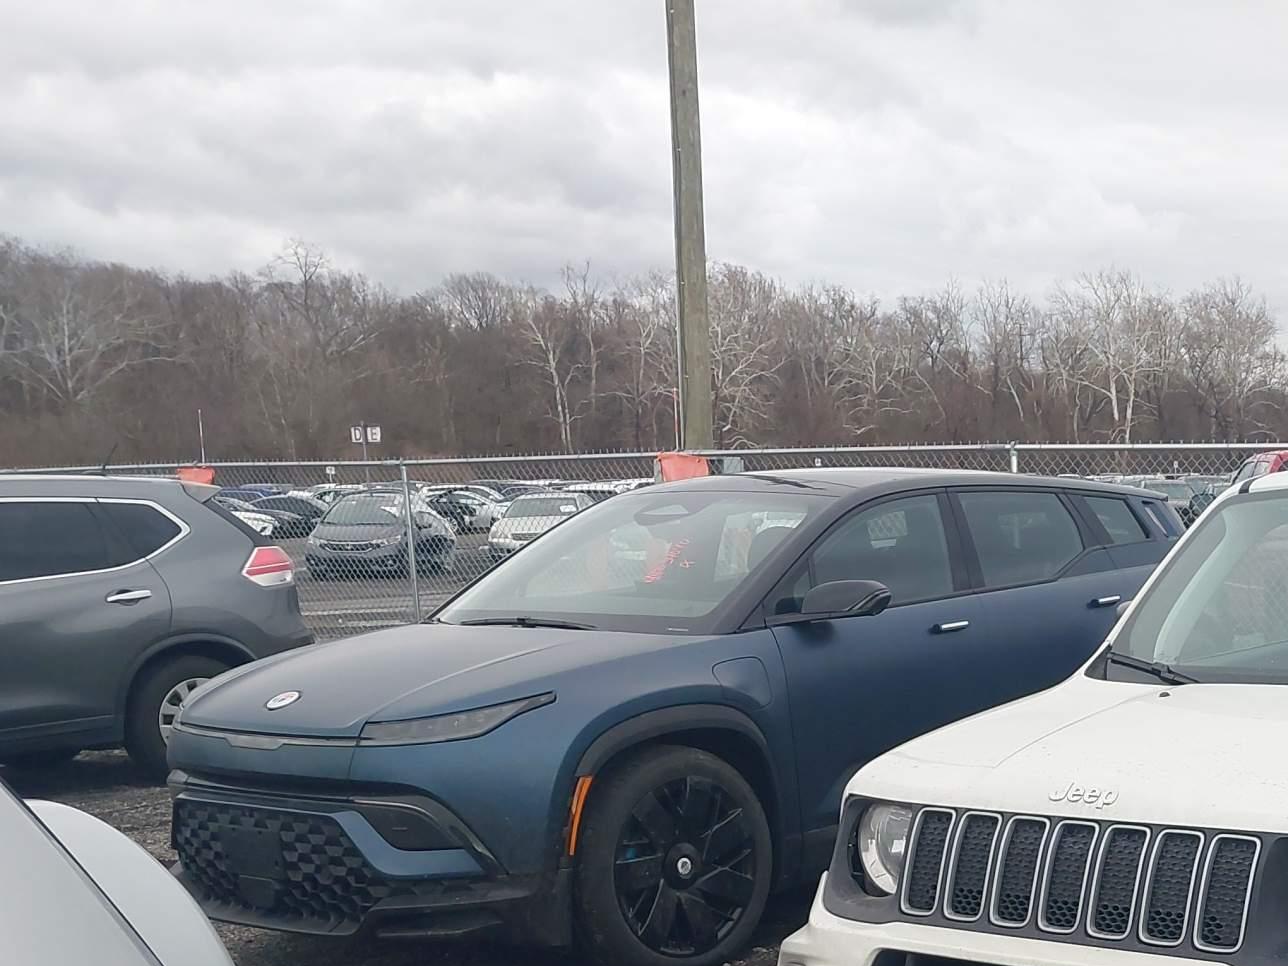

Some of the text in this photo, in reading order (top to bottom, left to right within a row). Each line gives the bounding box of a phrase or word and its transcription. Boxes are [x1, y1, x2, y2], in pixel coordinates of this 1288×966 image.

[354, 427, 361, 441] D
[370, 427, 378, 441] E
[1048, 781, 1119, 810] Jeep
